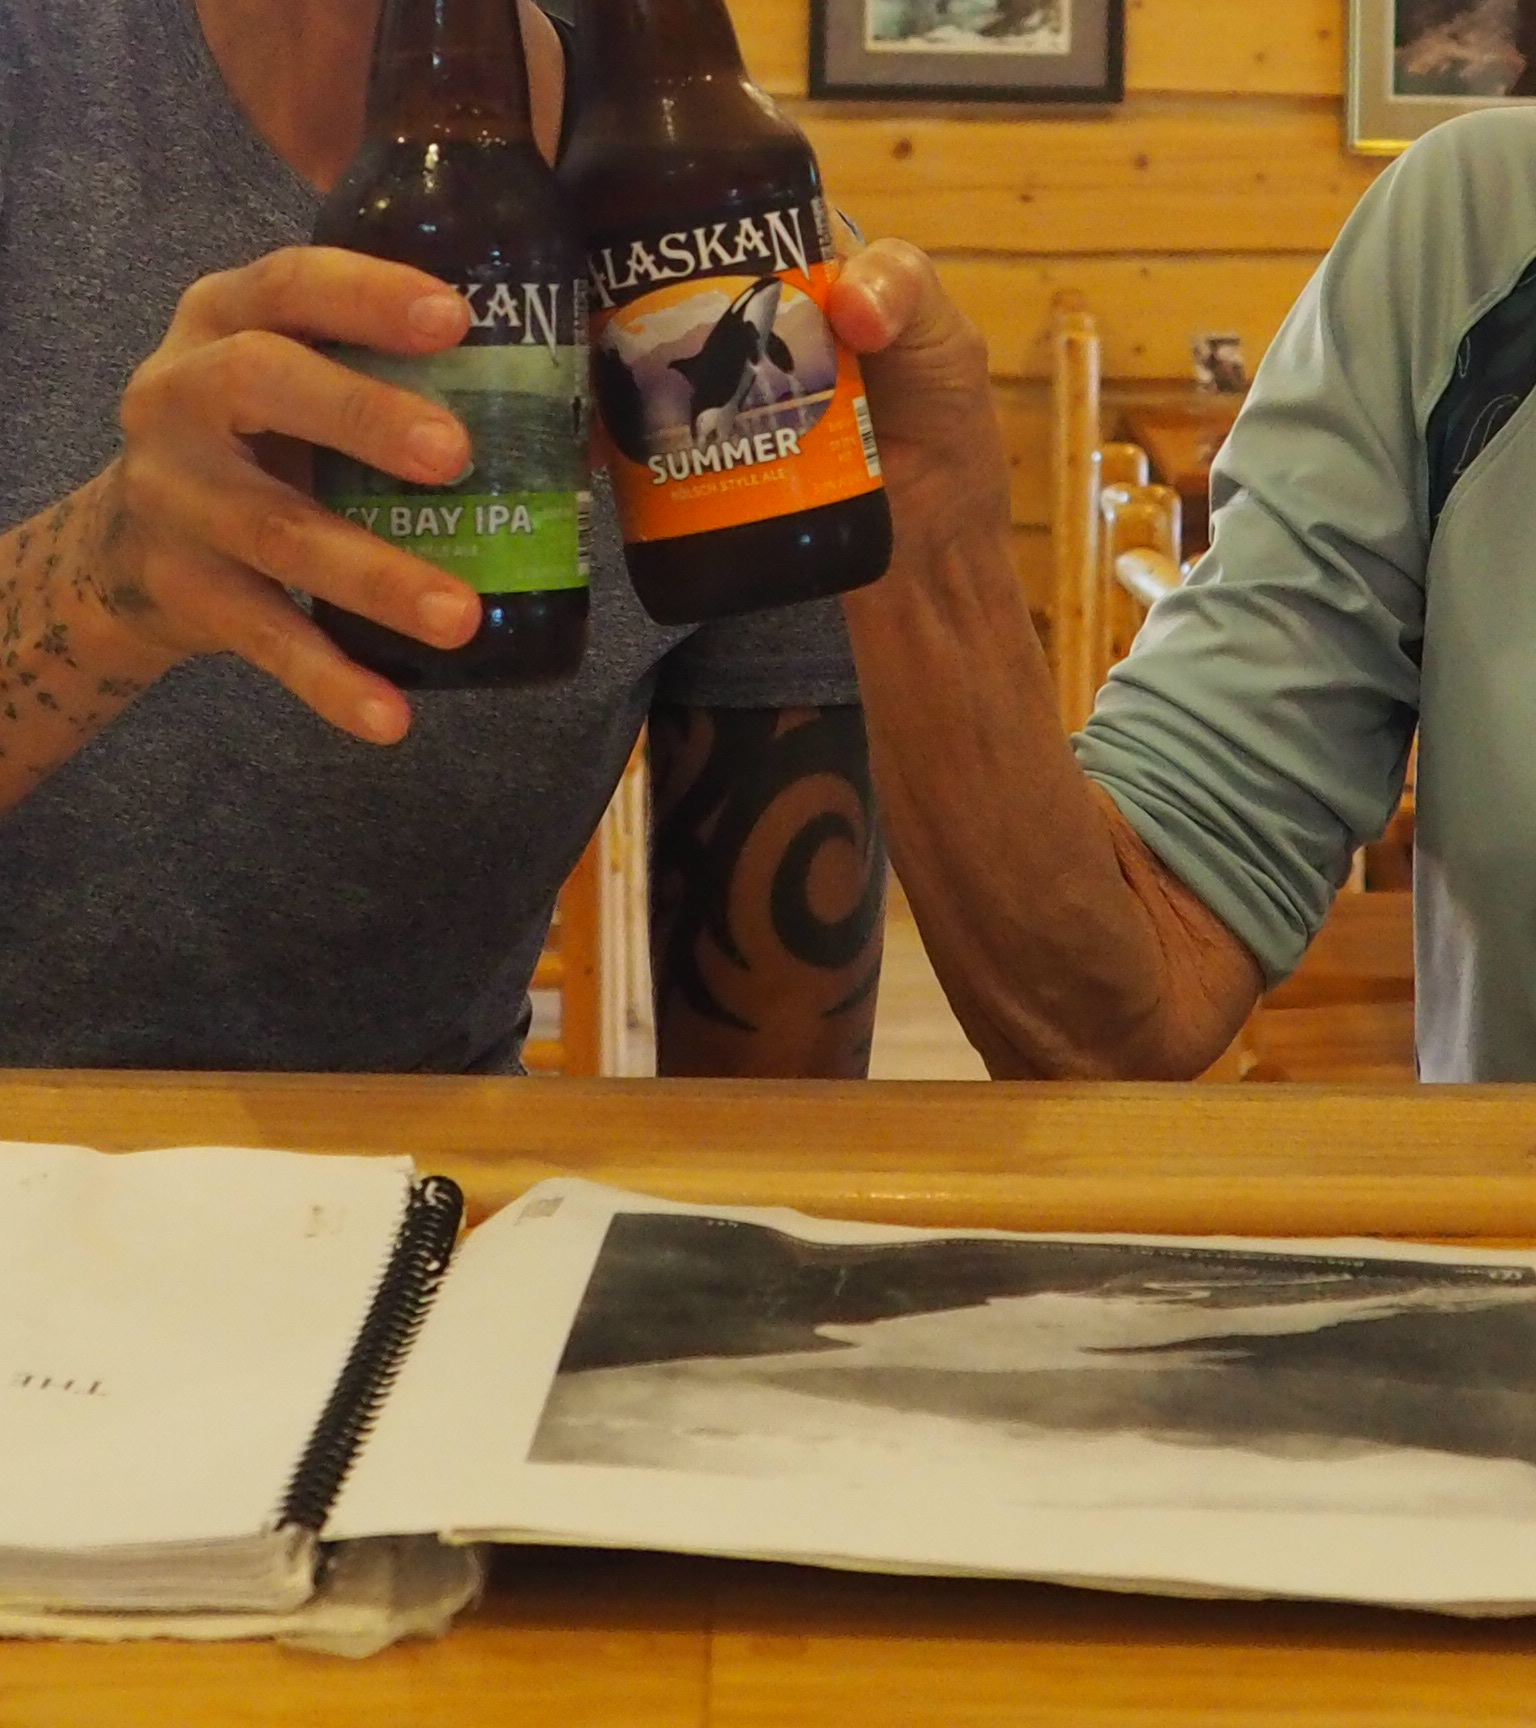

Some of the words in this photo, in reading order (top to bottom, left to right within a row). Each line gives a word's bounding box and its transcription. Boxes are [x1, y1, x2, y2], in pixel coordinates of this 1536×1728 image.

[647, 427, 802, 486] SUMMER
[762, 467, 787, 484] ALE
[390, 504, 464, 537] BAY
[475, 504, 534, 535] IPA
[9, 1371, 107, 1398] THE
